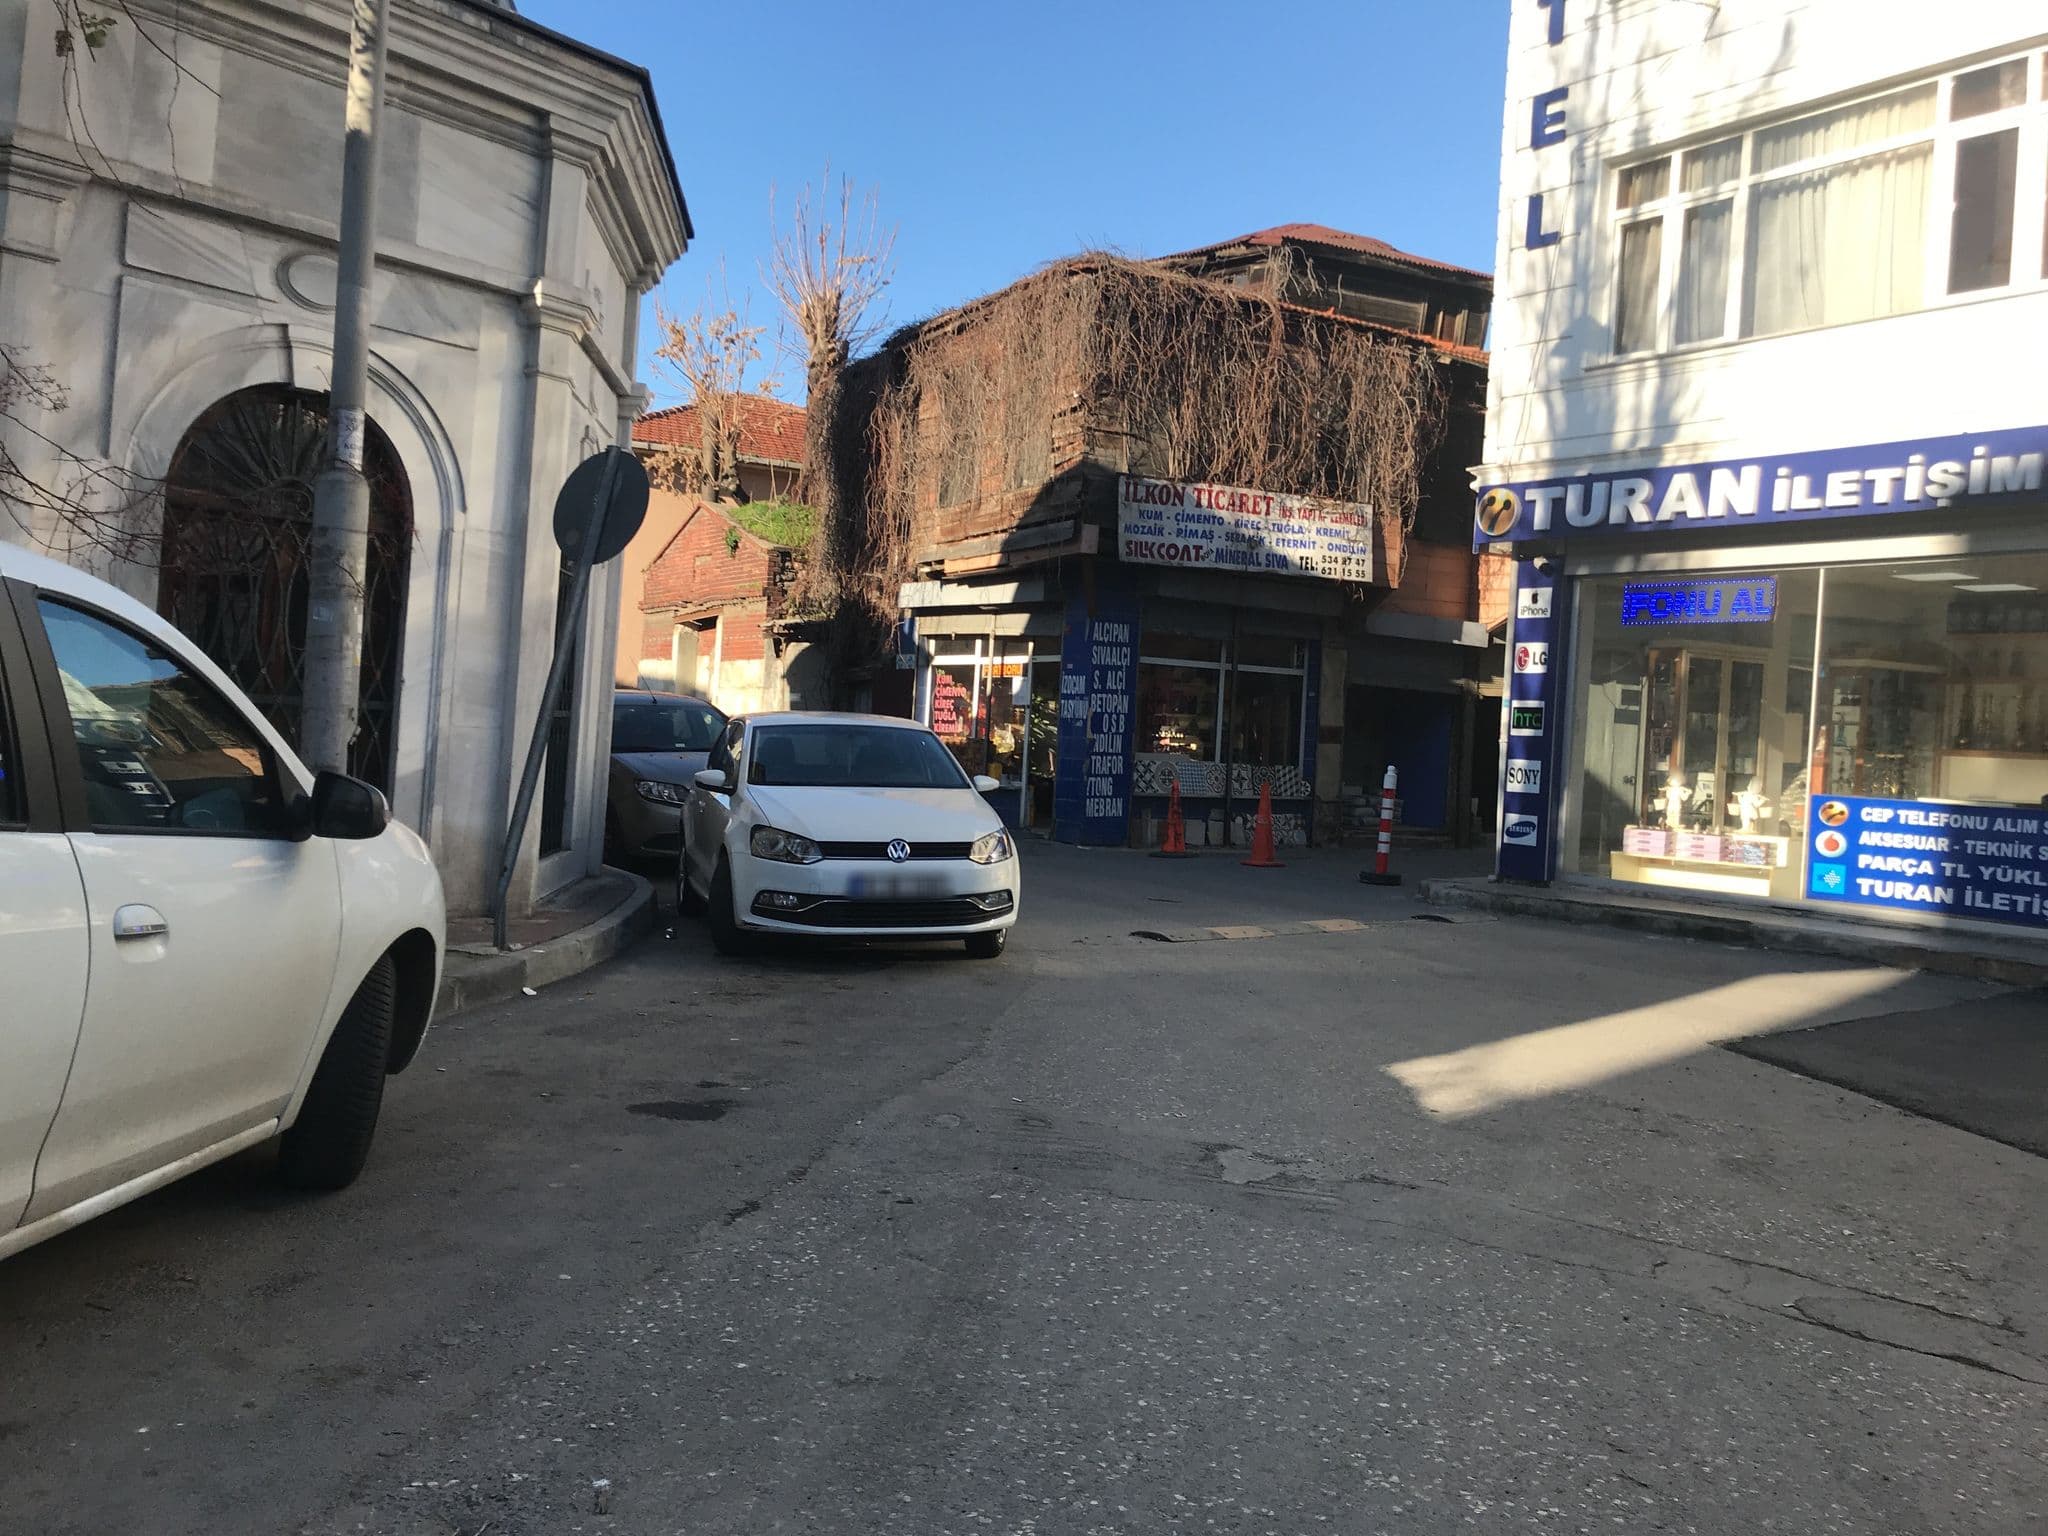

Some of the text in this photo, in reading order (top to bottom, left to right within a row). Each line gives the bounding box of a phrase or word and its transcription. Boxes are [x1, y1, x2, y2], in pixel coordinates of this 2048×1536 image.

[1193, 481, 1274, 516] TİCARET
[1525, 446, 2042, 533] TURAN İLETİŞİM
[1139, 509, 1163, 522] KUM
[1174, 509, 1225, 526] ÇİMENTO
[1124, 523, 1165, 537] MOZAİK
[1275, 536, 1317, 551] ETERNİT
[1214, 545, 1262, 567] MİNERAL
[1299, 555, 1318, 572] TEL:
[1321, 555, 1338, 564] 534
[1321, 566, 1366, 578] 621 15 55
[1520, 606, 1549, 616] iPhone
[1624, 588, 1772, 618] FONU AL
[1532, 651, 1548, 666] LG
[1091, 756, 1124, 775] TRAFOR
[1509, 767, 1539, 785] SONY
[1086, 797, 1123, 817] MEBRAN
[1861, 807, 1894, 823] CEP
[1897, 809, 1988, 830] TELEFONU
[1993, 817, 2038, 834] ALIM
[1859, 831, 1949, 851] AKSESUAR
[1965, 840, 2033, 859] TEKNİK
[1858, 854, 1934, 876] PARÇA
[1941, 861, 1971, 878] TL
[1856, 878, 1954, 904] TURAN
